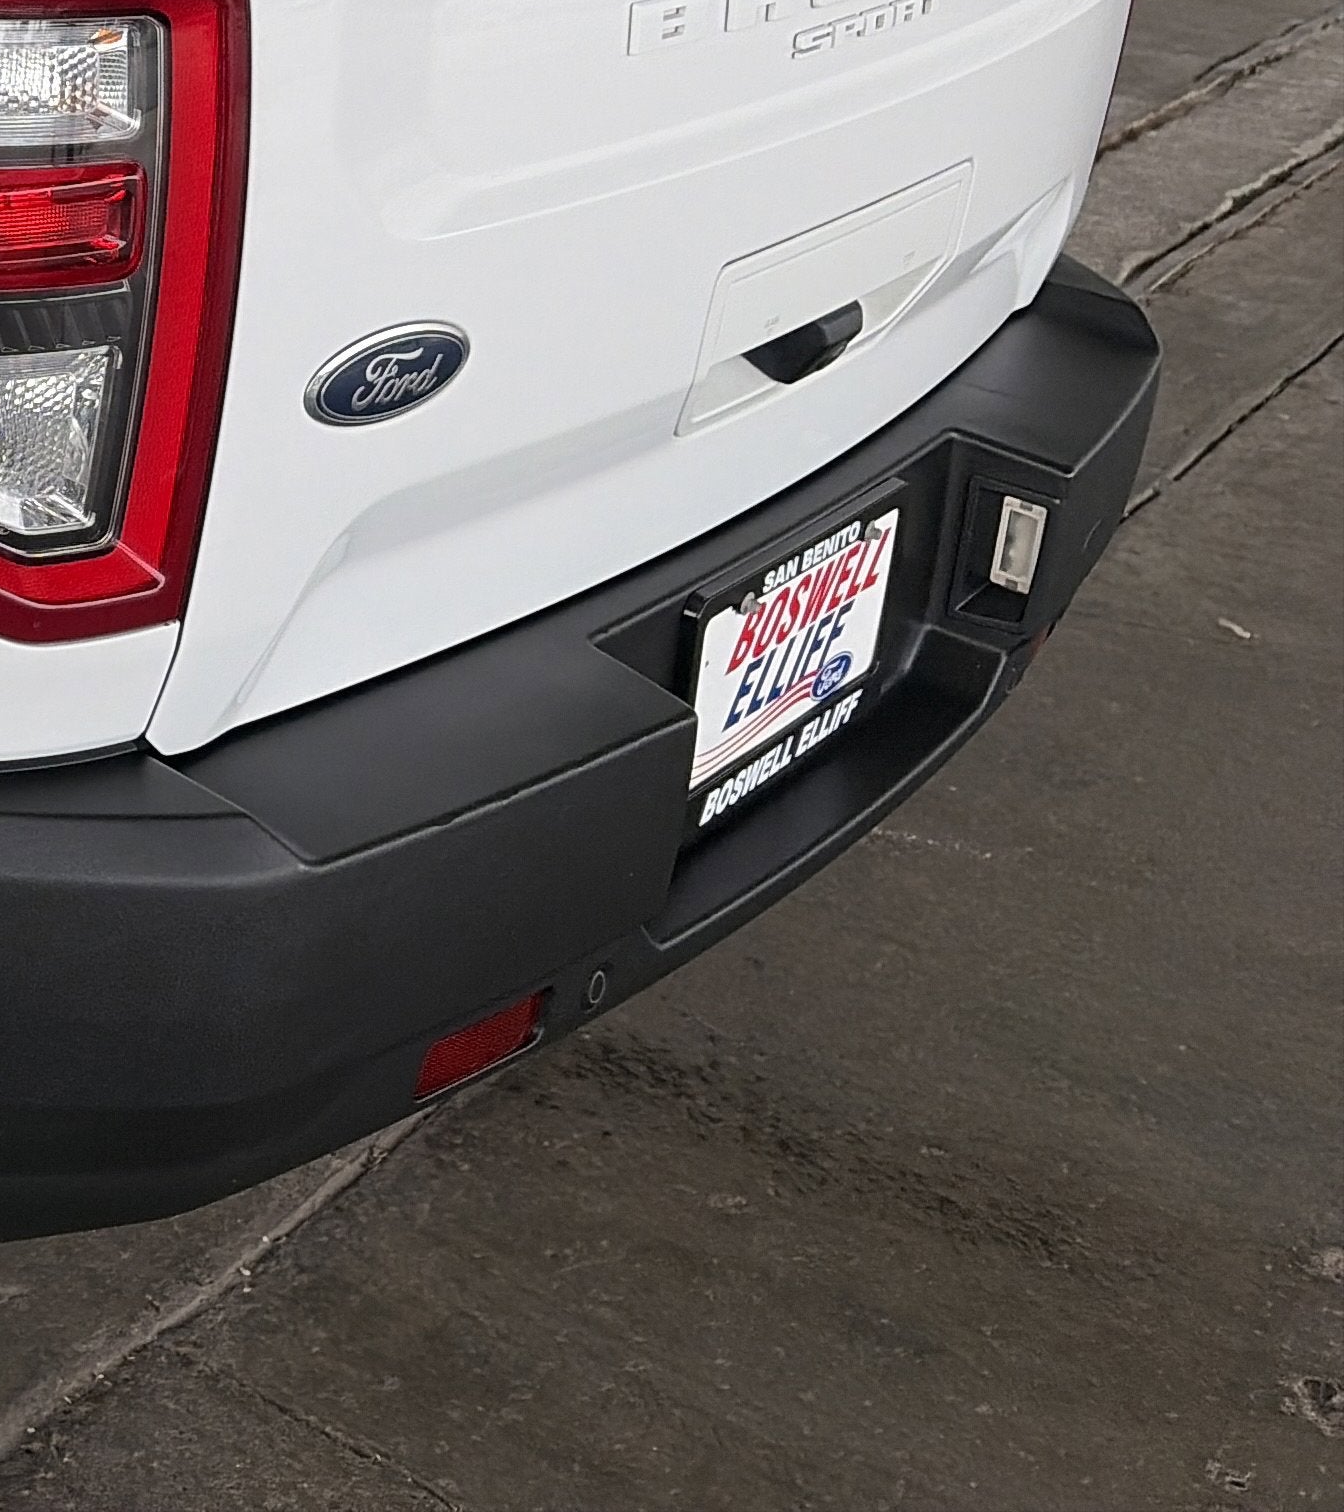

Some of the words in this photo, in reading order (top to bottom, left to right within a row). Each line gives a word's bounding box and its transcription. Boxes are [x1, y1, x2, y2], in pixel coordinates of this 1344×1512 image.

[351, 347, 444, 412] Ford
[725, 526, 892, 676] BOSWELL
[762, 562, 799, 594] SAN
[801, 520, 863, 573] BENITO
[722, 599, 854, 734] ELLIFF
[699, 735, 796, 828] BOSWELL
[794, 688, 864, 758] ELLIFF
